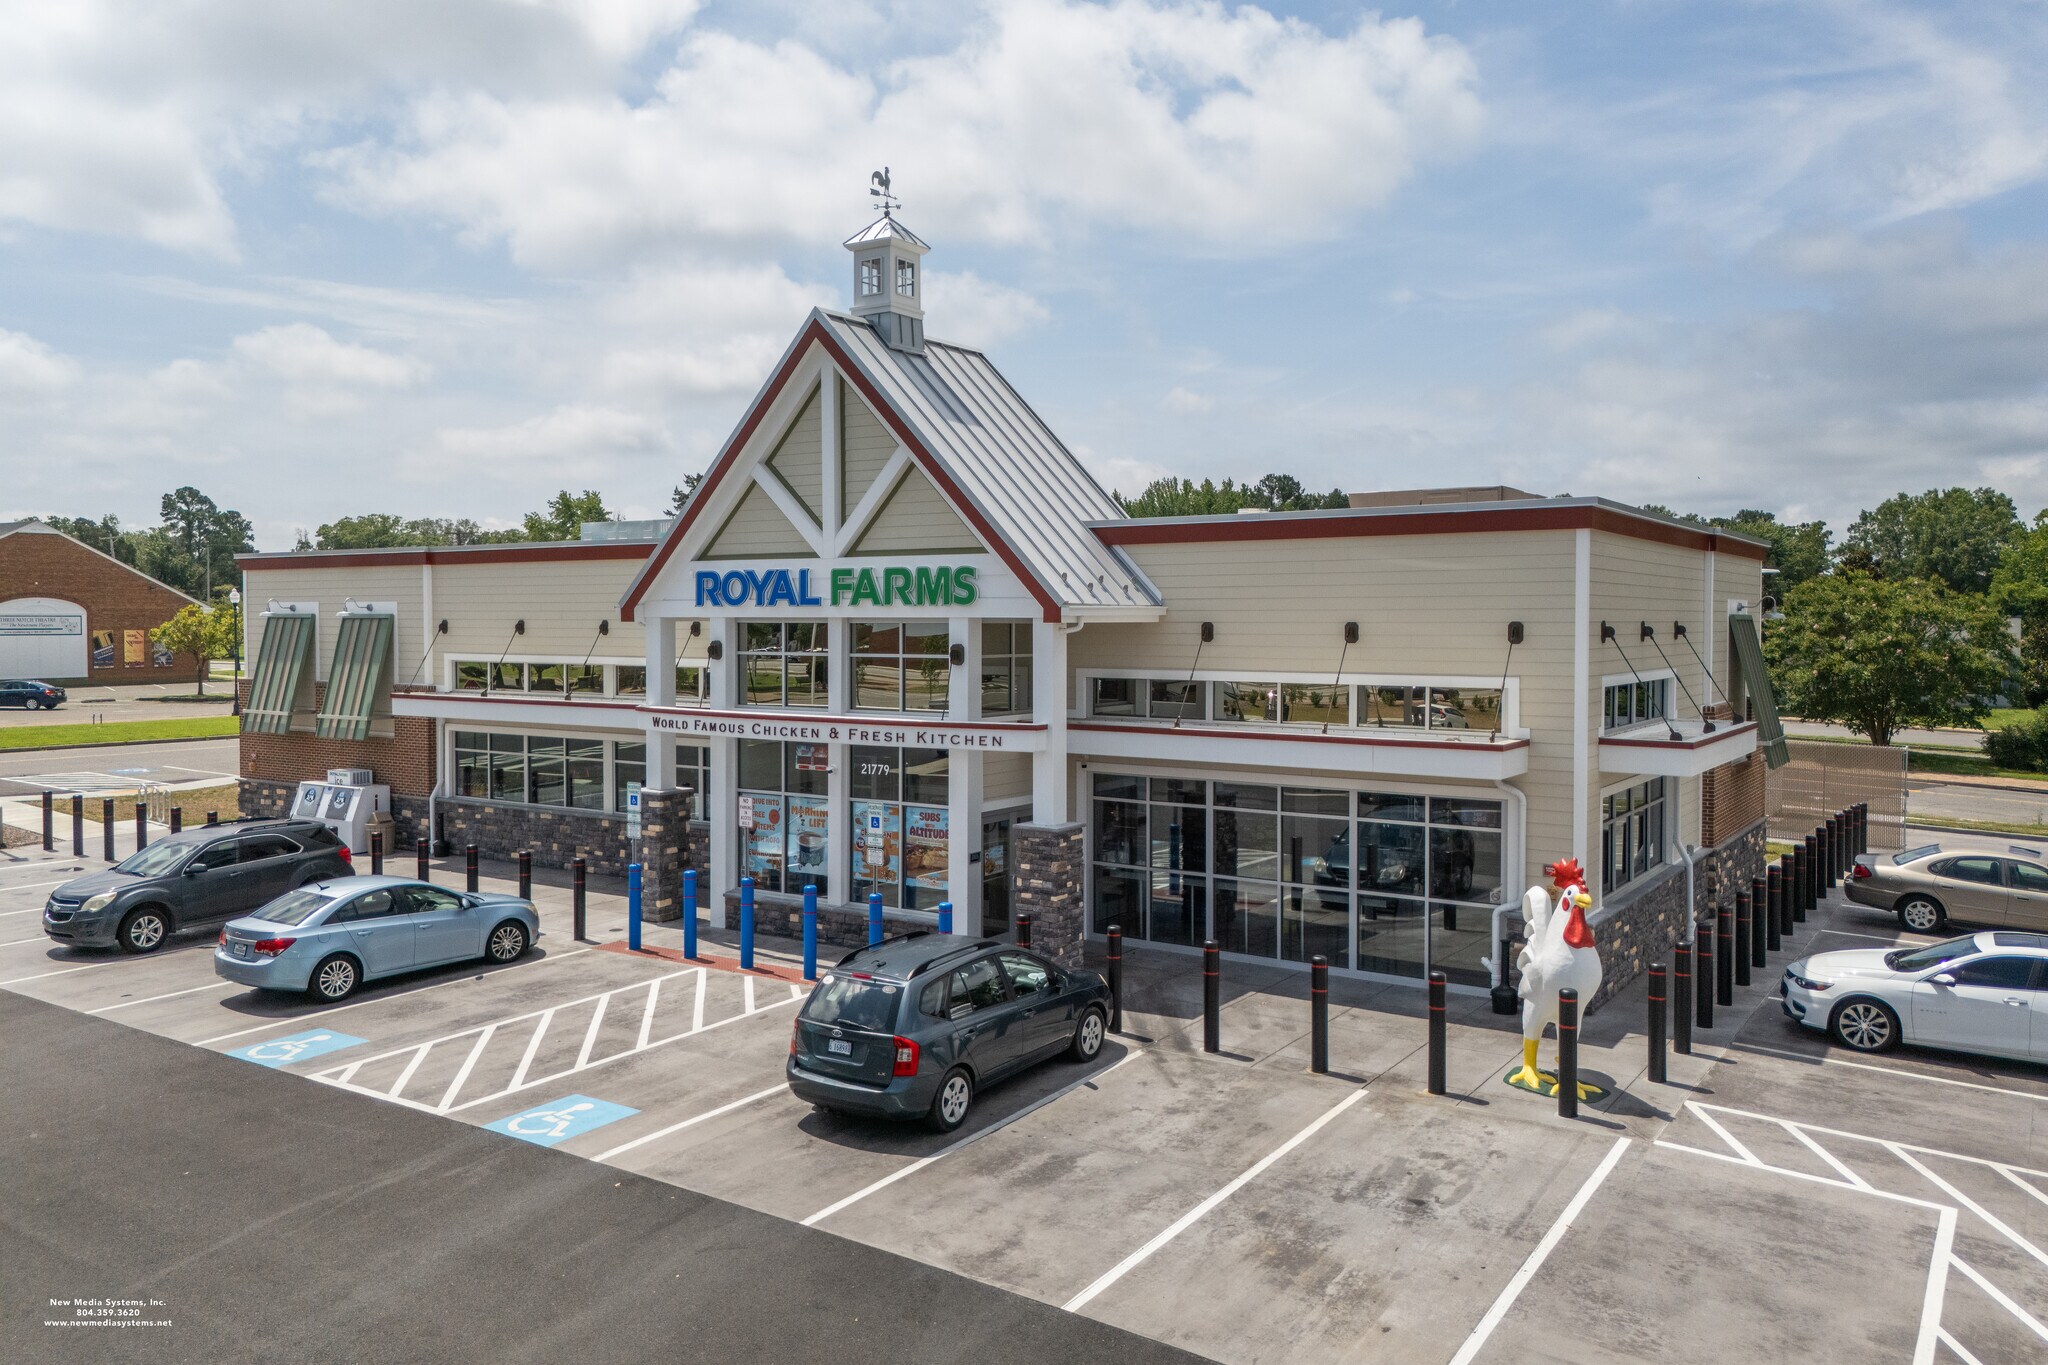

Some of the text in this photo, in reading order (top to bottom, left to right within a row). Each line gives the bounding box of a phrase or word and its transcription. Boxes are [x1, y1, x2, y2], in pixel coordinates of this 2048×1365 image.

[695, 565, 978, 607] ROYAL FARMS
[652, 717, 1003, 747] WORLD FAMOUS CHICKEN & FRESH KITCHEN
[861, 763, 890, 776] 21779
[809, 818, 827, 828] LIFT
[920, 812, 941, 823] SUBS
